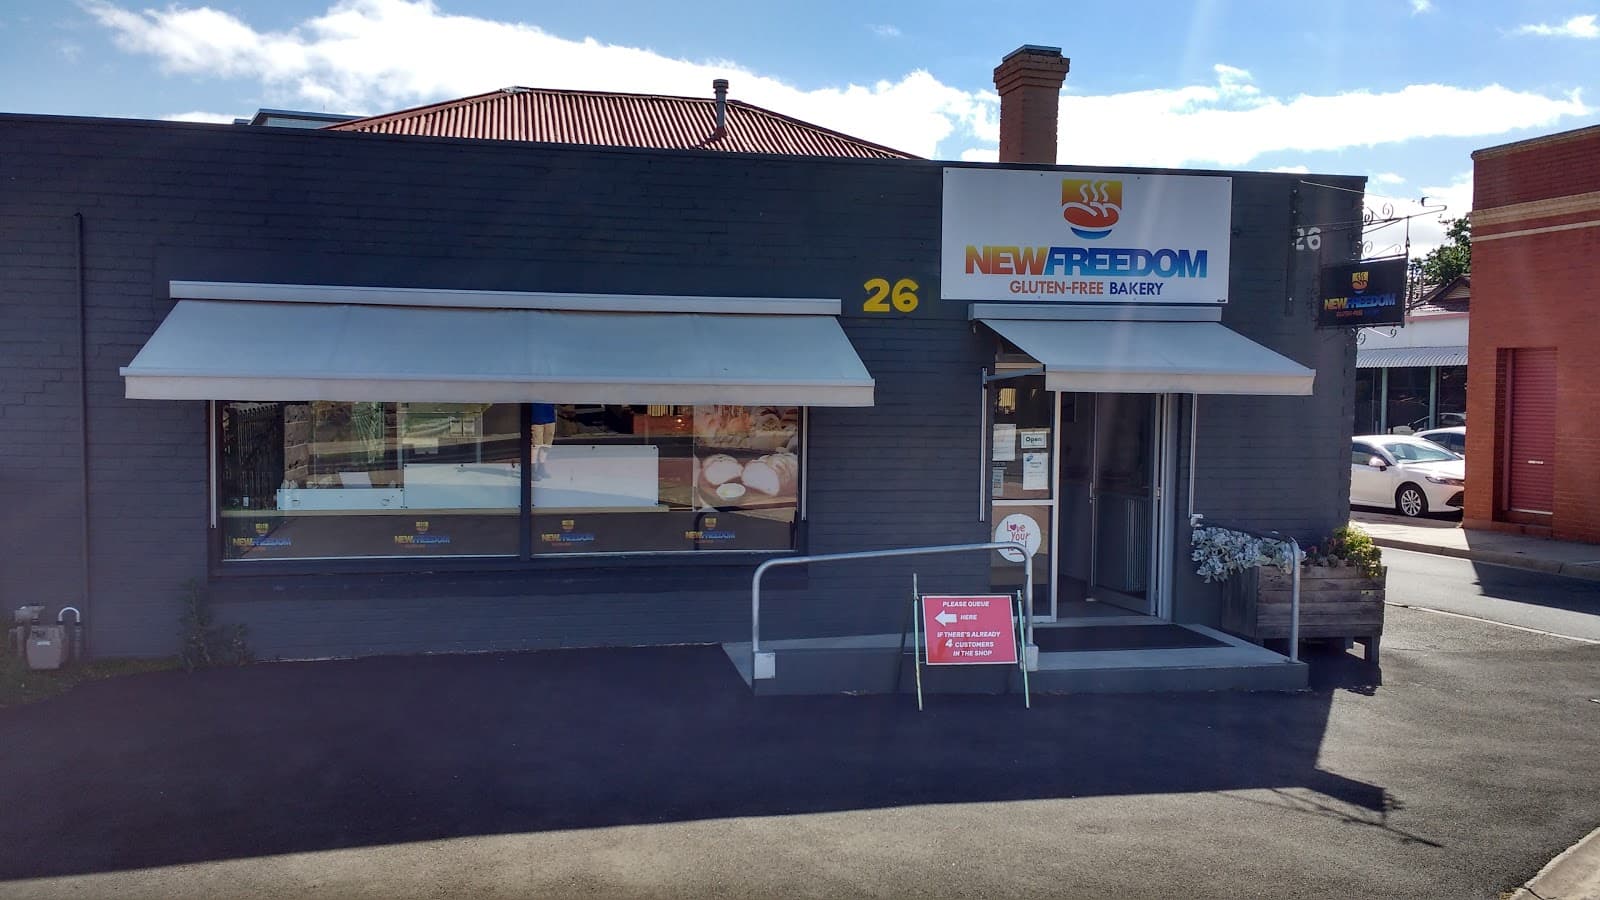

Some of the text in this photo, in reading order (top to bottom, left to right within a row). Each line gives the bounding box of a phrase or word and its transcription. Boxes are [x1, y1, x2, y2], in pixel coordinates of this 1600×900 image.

[1296, 227, 1321, 250] 26
[965, 245, 1208, 278] NEWFREEDOM
[863, 278, 919, 313] 26
[1009, 280, 1164, 296] GLUTEN-FREE BAKERY
[945, 638, 954, 648] 4
